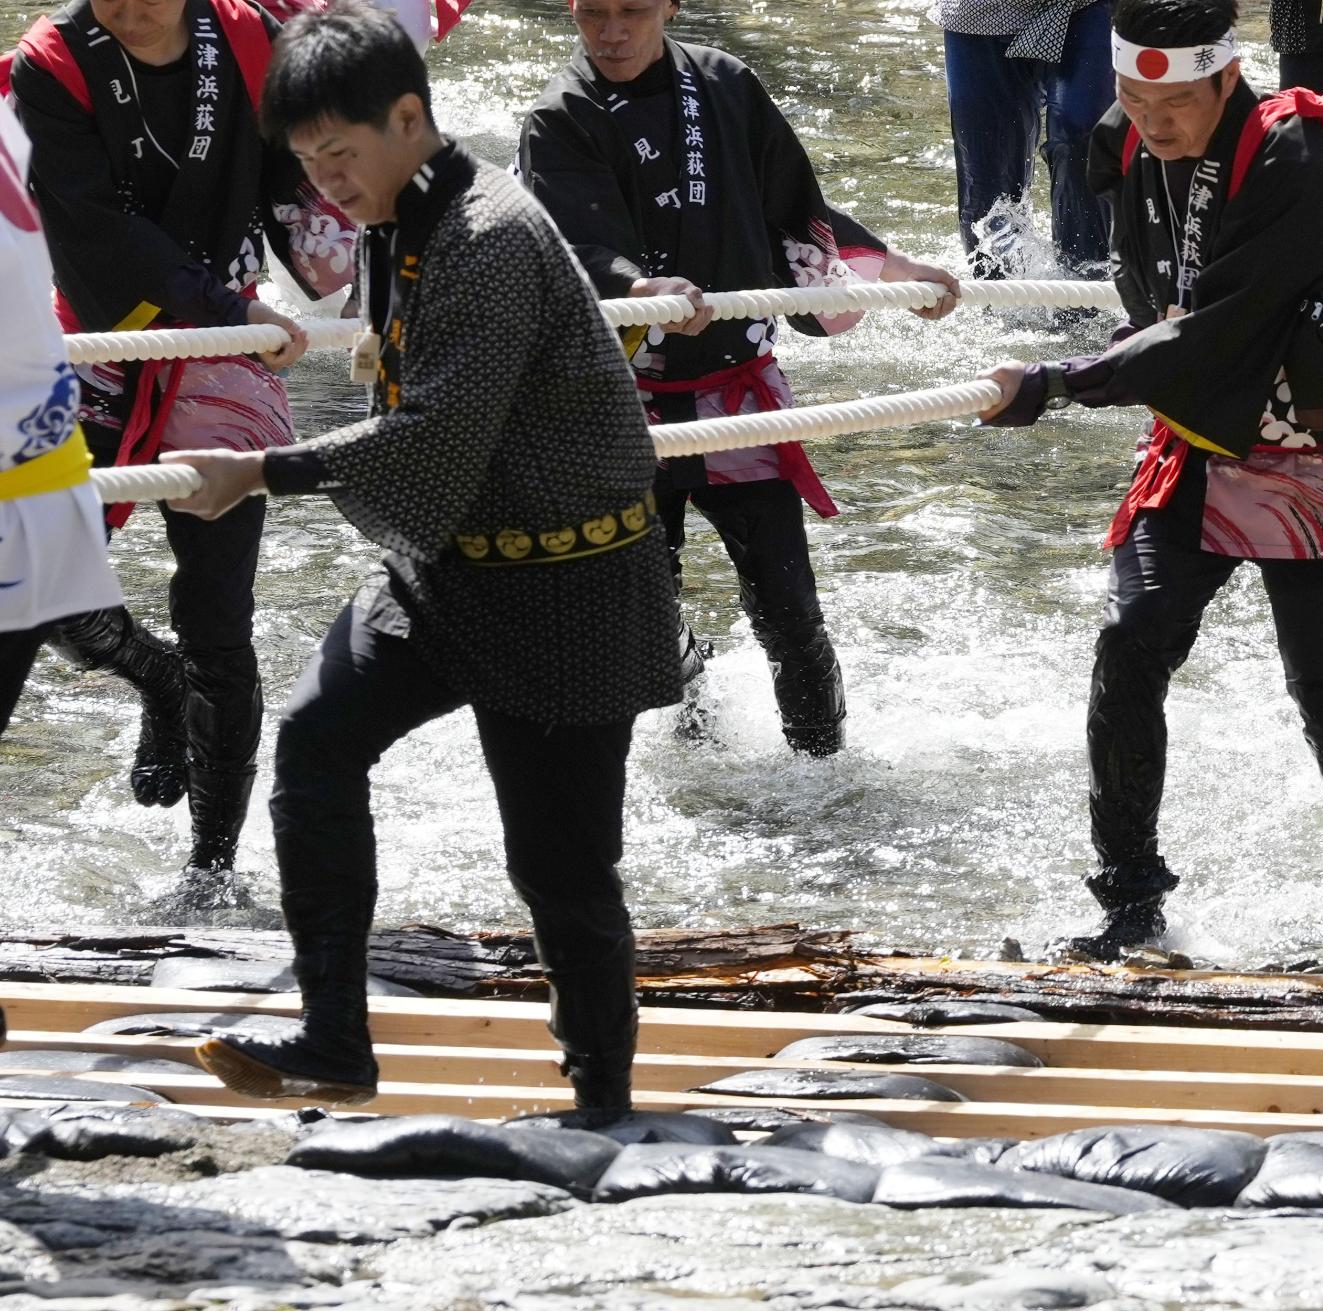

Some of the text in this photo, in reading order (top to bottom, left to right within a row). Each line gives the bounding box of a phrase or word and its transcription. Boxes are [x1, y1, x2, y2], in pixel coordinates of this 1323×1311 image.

[187, 17, 220, 162] 三津浜荻団
[606, 92, 682, 210] 二見町
[679, 70, 707, 207] 三津浜荻団
